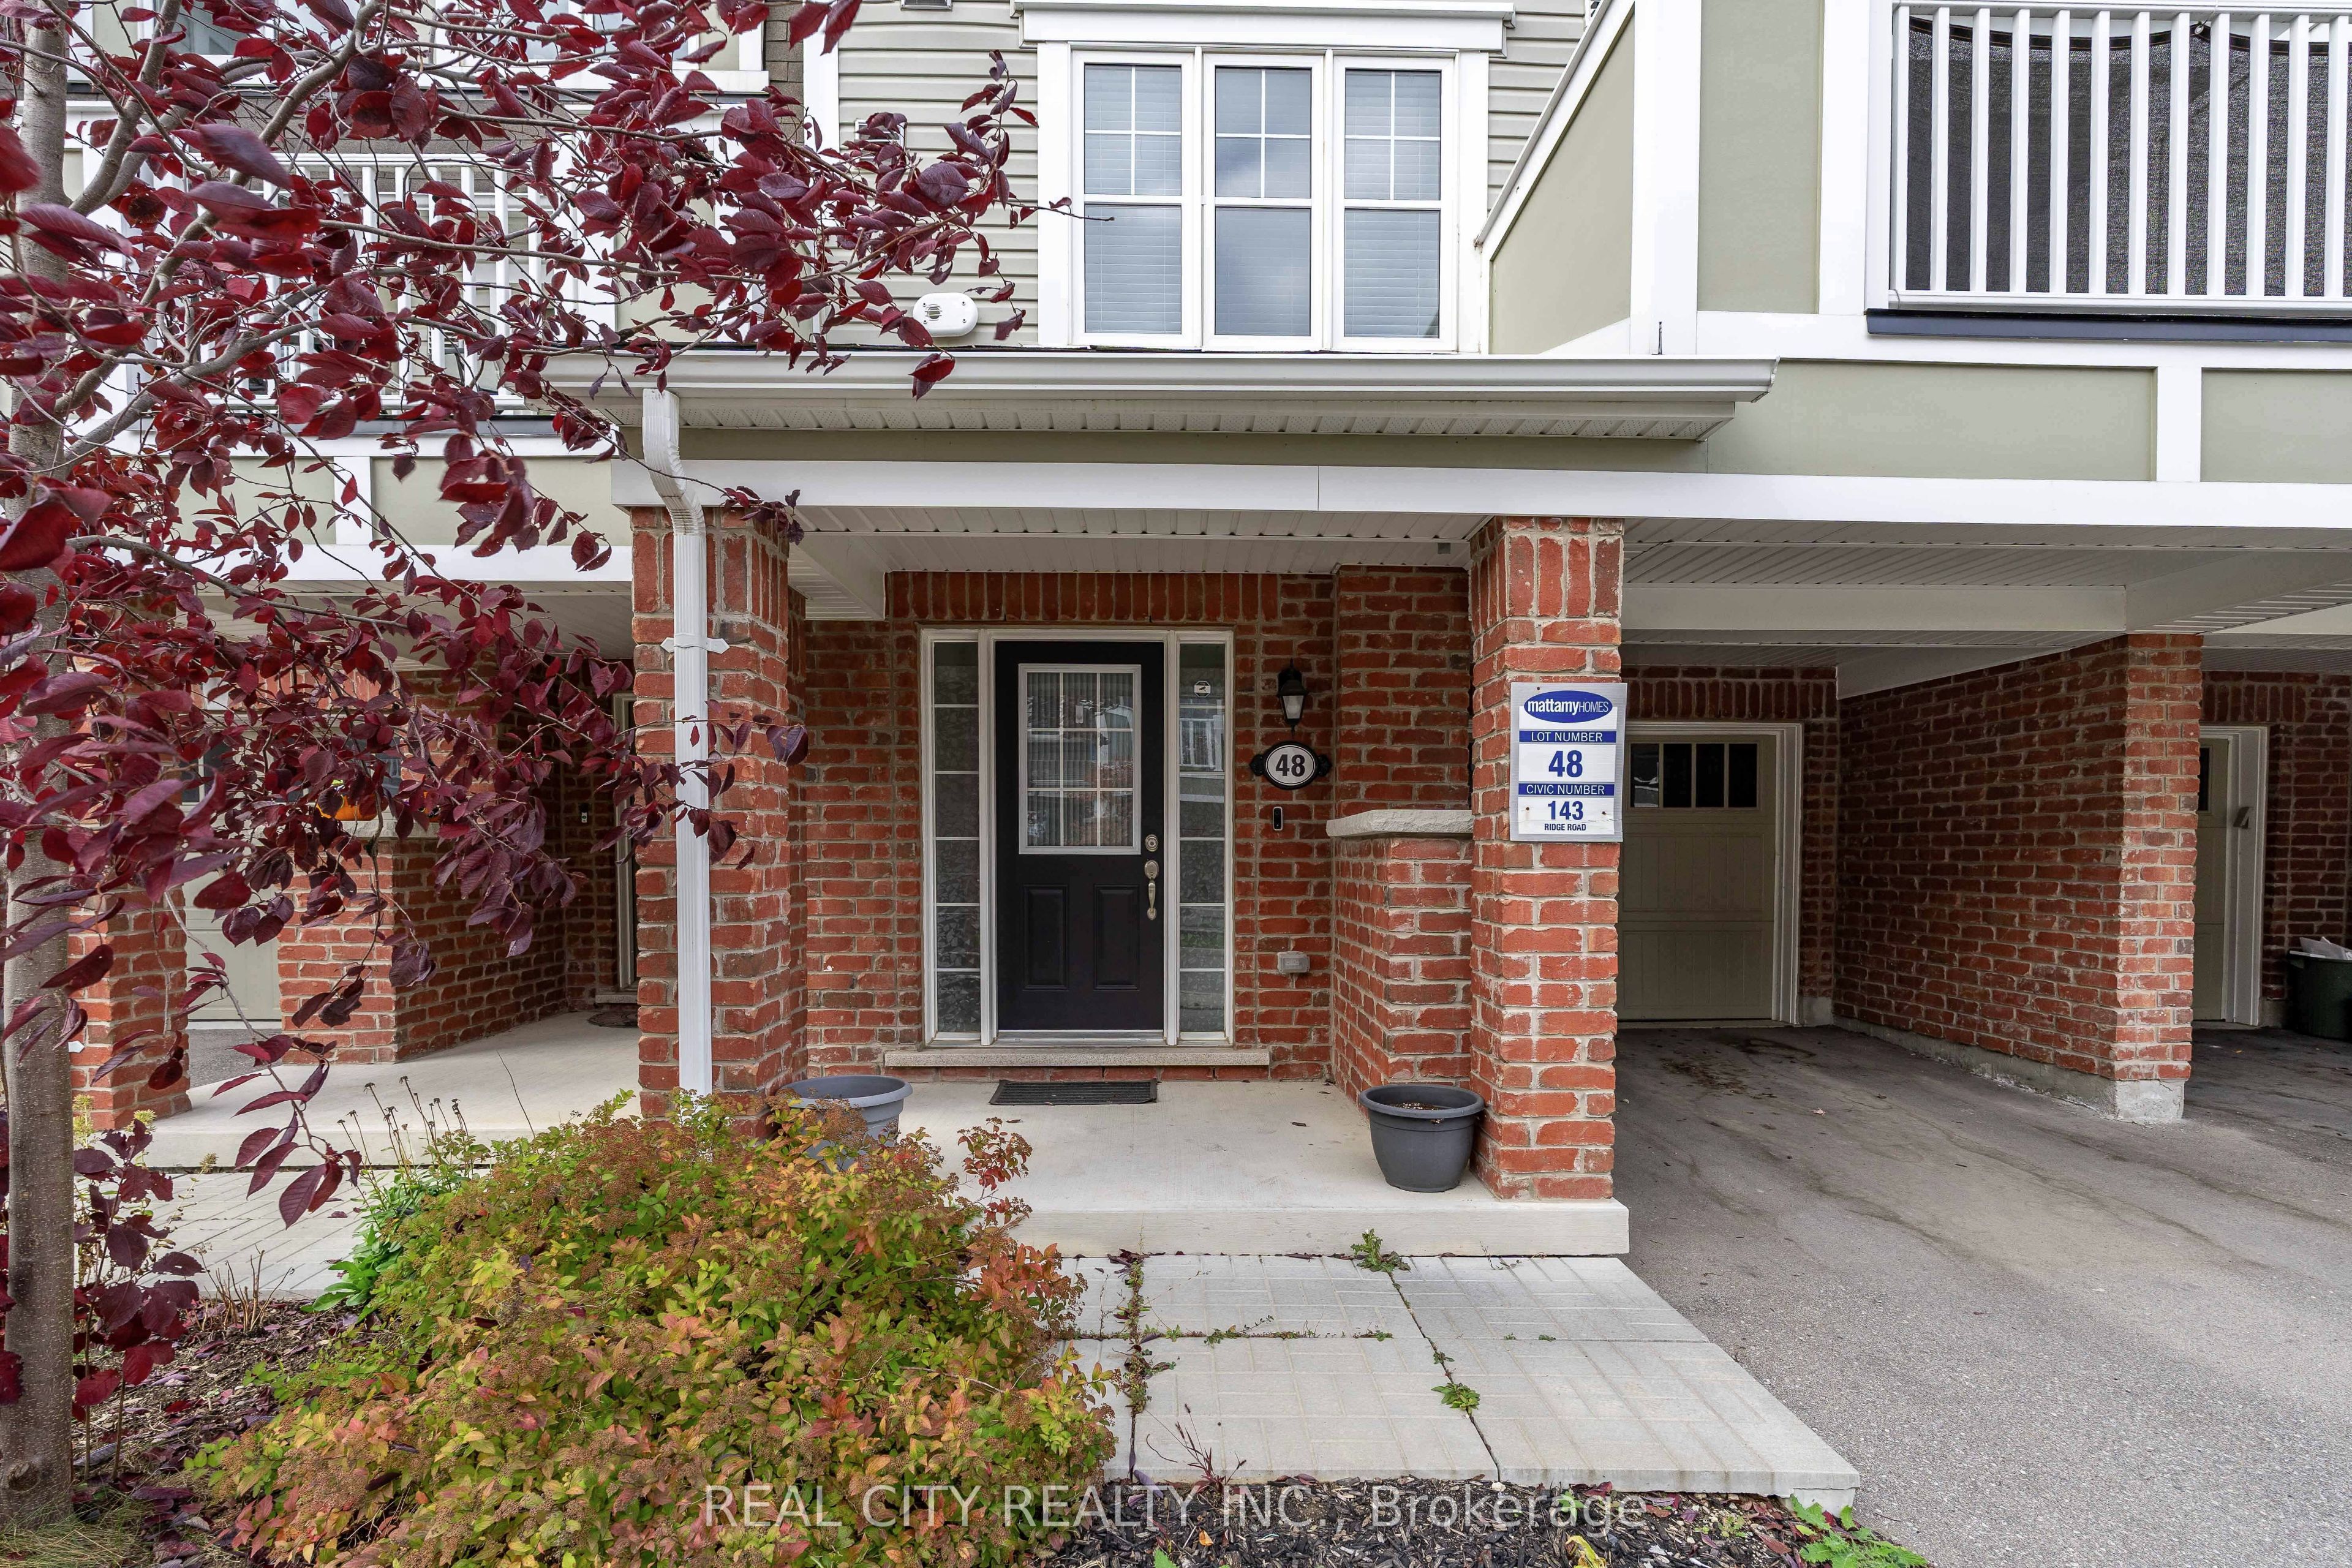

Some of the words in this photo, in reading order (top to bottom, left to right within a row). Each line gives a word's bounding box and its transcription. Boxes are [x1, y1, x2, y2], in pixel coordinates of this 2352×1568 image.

[1528, 699, 1609, 715] mattamyHOMES
[1531, 732, 1552, 742] LOT
[1555, 732, 1603, 742] NUMBER
[1275, 754, 1305, 777] 48
[1548, 750, 1583, 778] 48
[1526, 784, 1554, 794] CIVIC
[1558, 785, 1605, 795] NUMBER
[1548, 801, 1583, 820] 143
